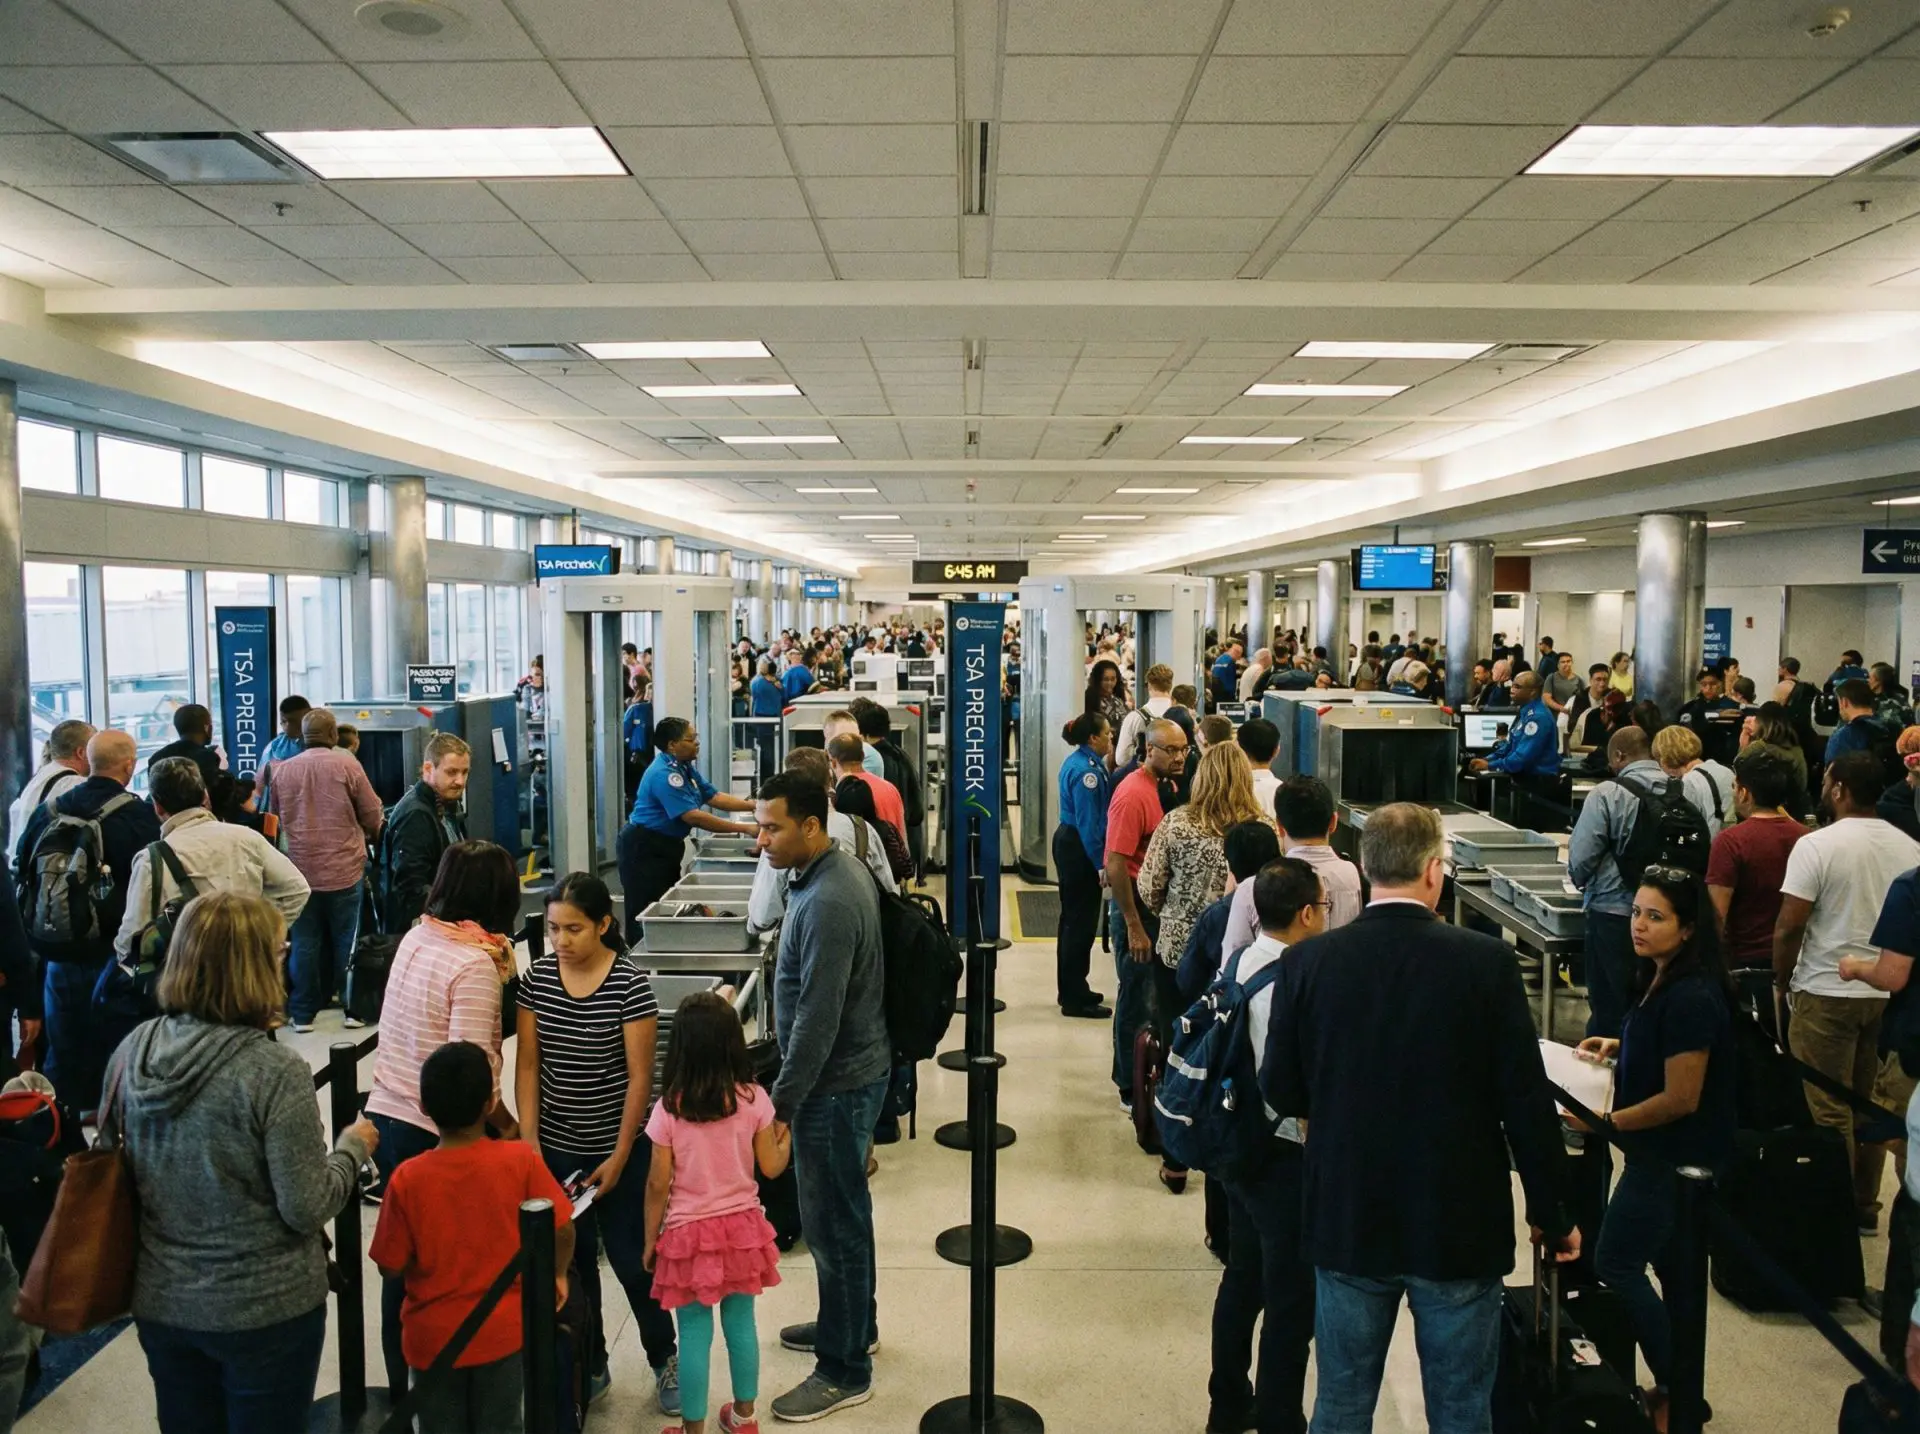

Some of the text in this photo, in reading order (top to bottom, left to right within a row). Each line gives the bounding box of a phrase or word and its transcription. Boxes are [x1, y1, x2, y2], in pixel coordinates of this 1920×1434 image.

[537, 560, 554, 569] TSA
[976, 564, 996, 579] AM
[233, 648, 254, 686] TSA
[965, 644, 985, 682] TSA
[235, 693, 257, 780] PRECHEC
[965, 688, 985, 791] PRECHECK
